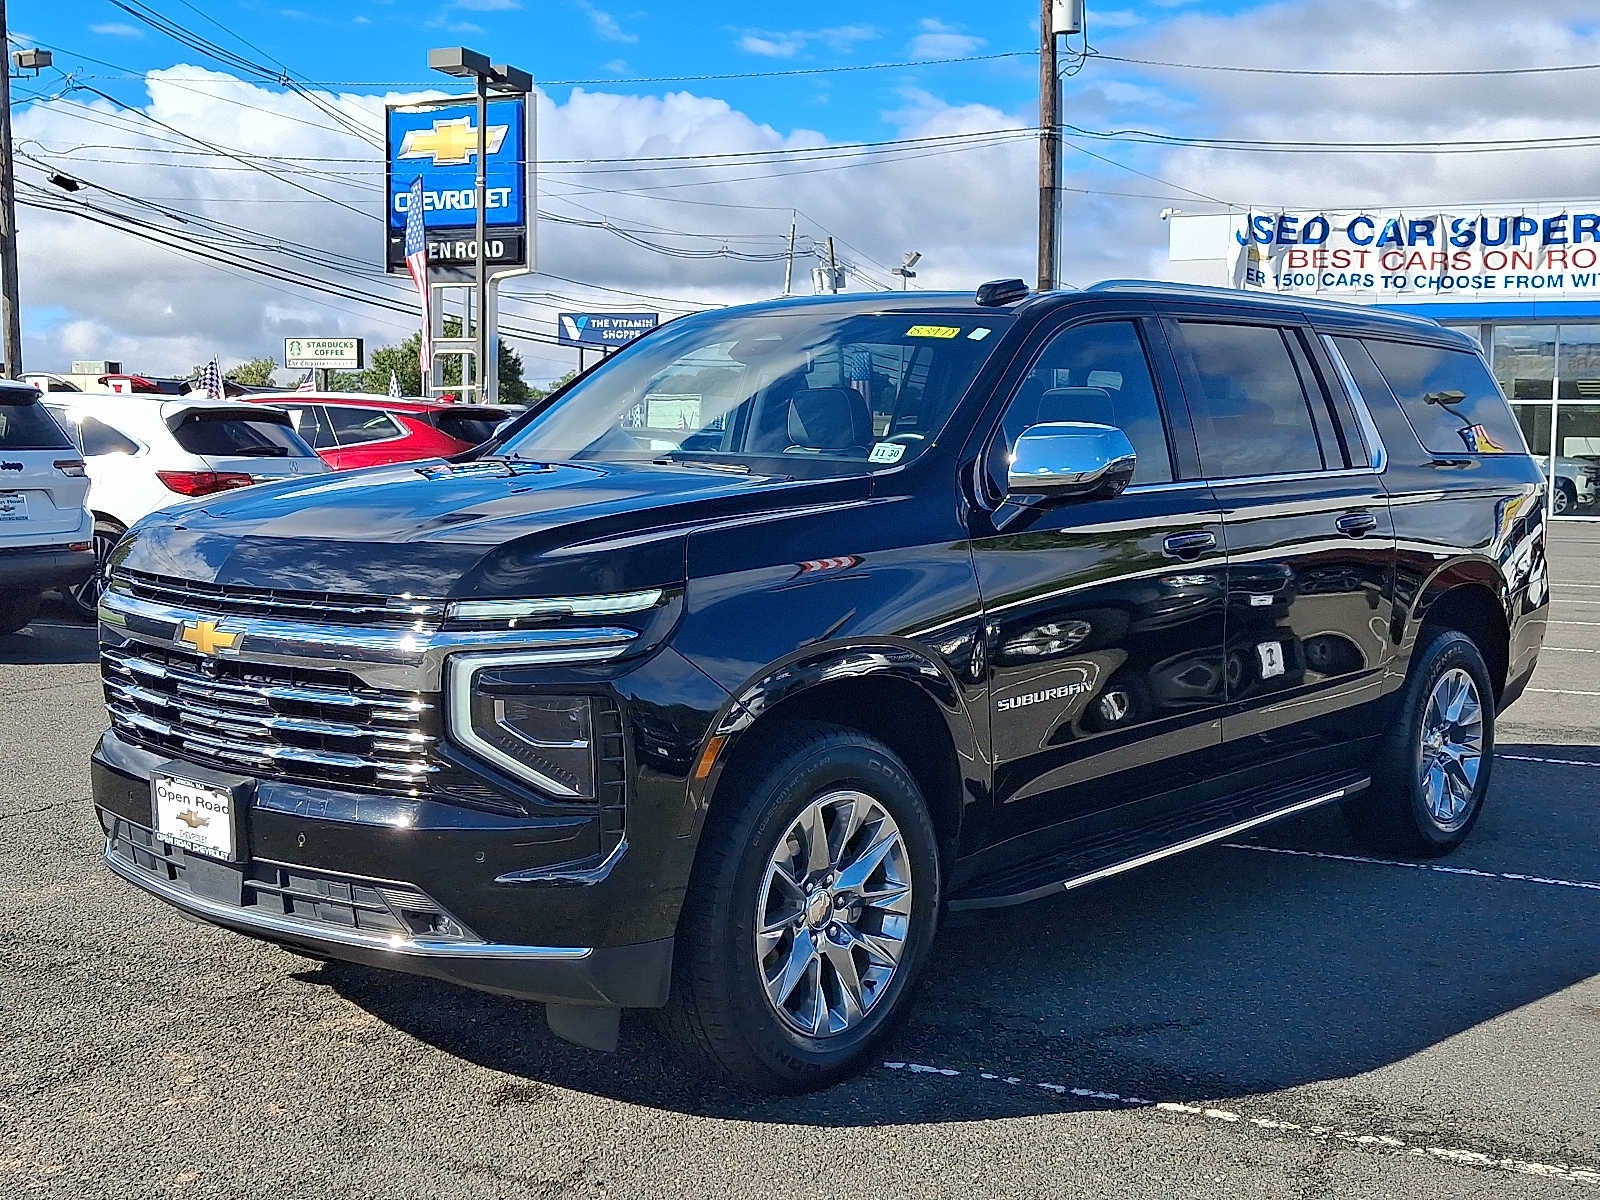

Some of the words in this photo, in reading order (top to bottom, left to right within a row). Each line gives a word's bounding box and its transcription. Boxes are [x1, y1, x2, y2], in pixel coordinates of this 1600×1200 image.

[394, 187, 512, 212] CEVROET
[1347, 216, 1435, 247] CAR
[1450, 214, 1600, 247] SUPER
[1288, 249, 1373, 269] BEST
[1381, 250, 1472, 271] CARS
[1483, 250, 1533, 270] ON
[1547, 248, 1597, 269] RO
[1273, 273, 1315, 286] 1500
[1322, 273, 1374, 287] CARS
[1381, 275, 1407, 288] TO
[1414, 275, 1496, 289] CHOOSE
[1504, 274, 1563, 289] FROM
[591, 320, 610, 328] THE
[611, 320, 653, 328] VITAMIN
[997, 680, 1093, 712] SUBURBAN
[157, 786, 191, 805] Open
